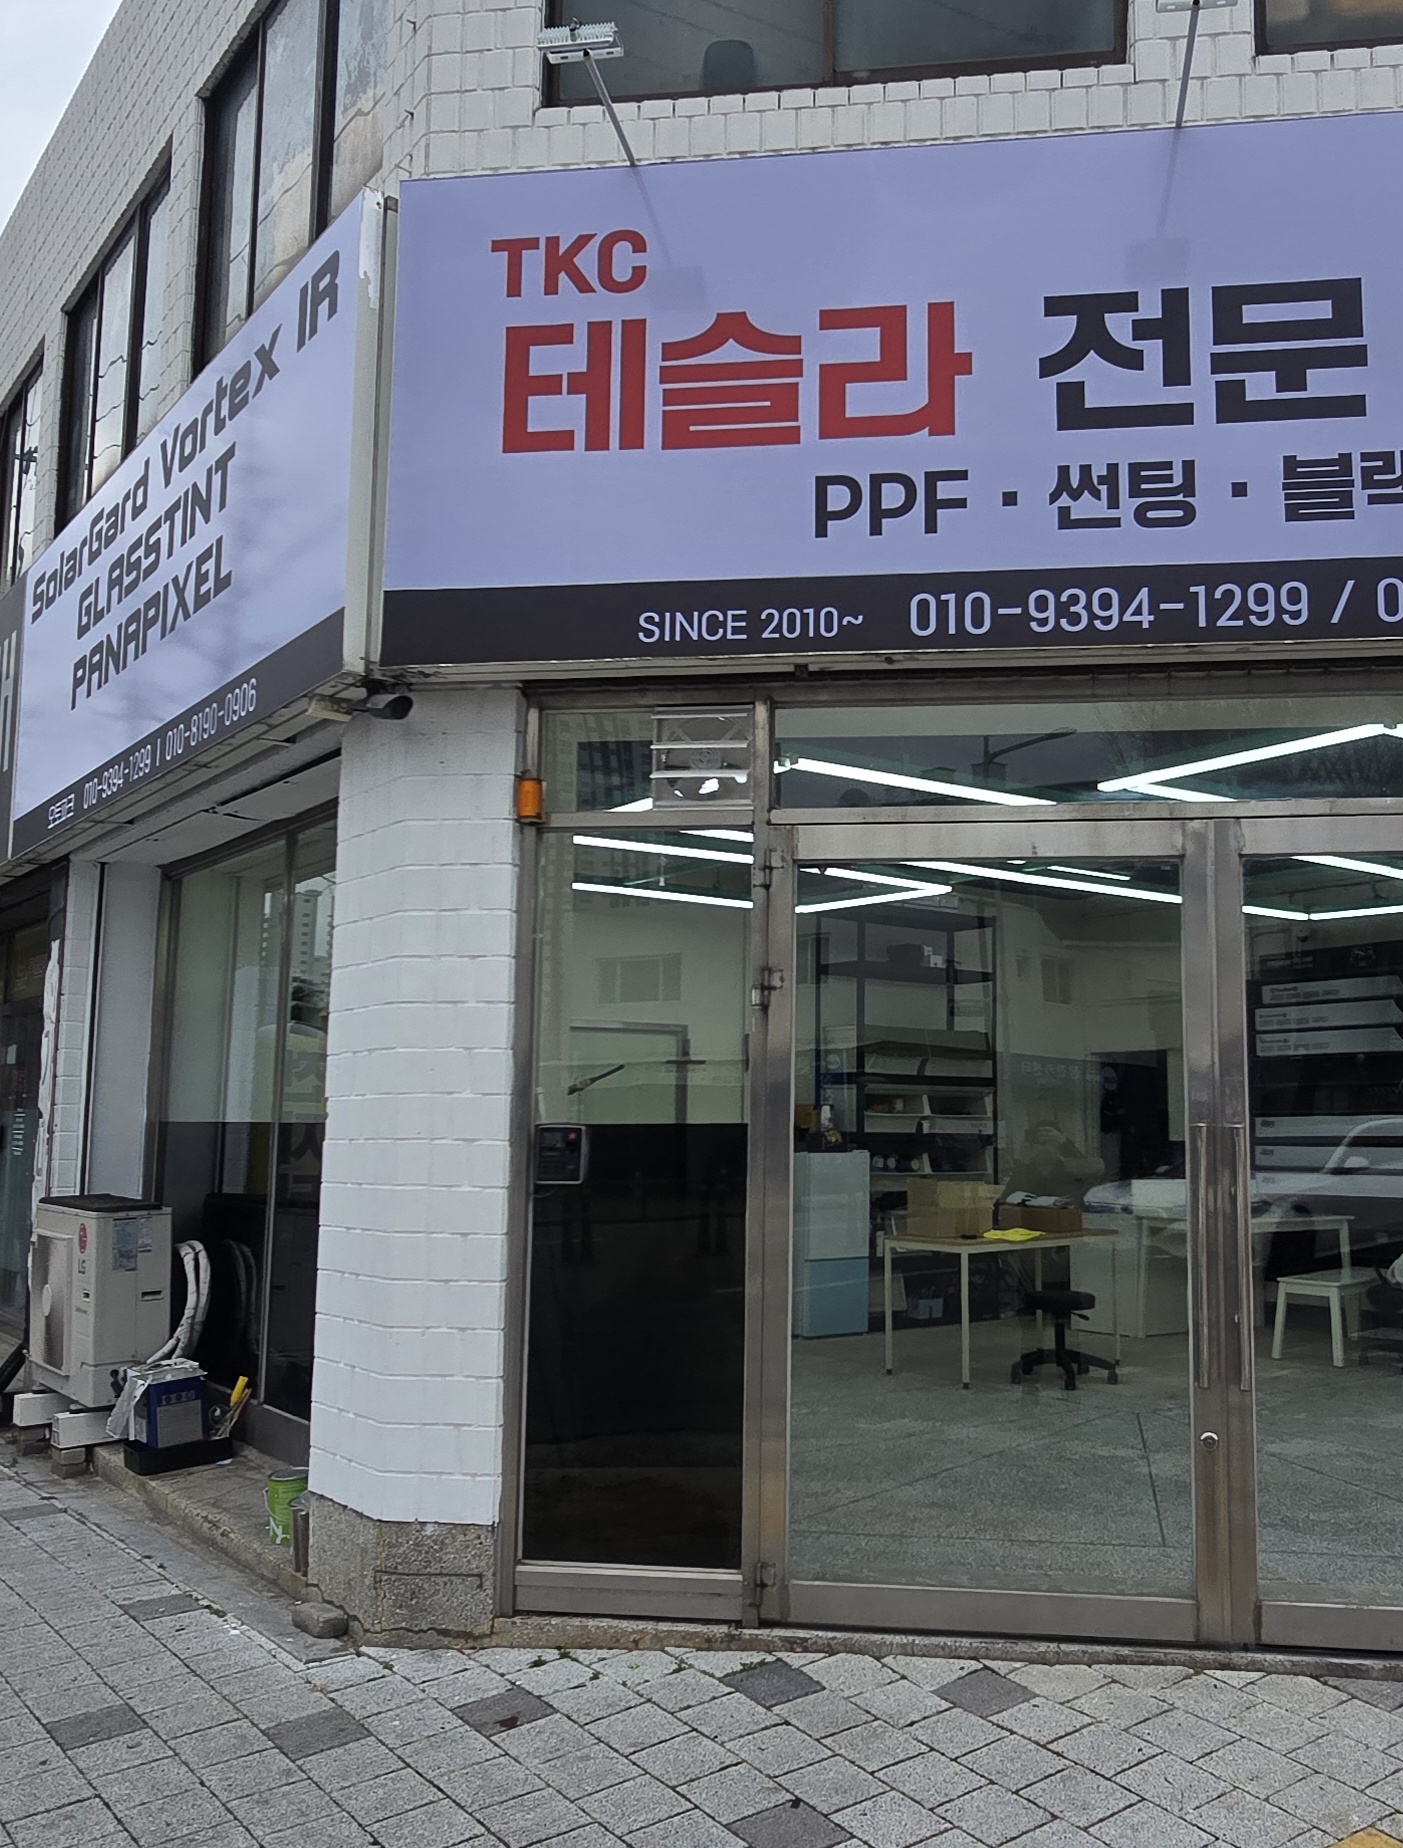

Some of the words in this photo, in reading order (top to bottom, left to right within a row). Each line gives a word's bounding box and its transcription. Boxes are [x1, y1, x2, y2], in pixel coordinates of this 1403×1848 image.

[491, 230, 648, 299] TKC
[31, 456, 150, 625] SolarGard
[160, 322, 283, 490] Vortex
[296, 249, 340, 354] IR
[502, 301, 974, 455] 테슬라
[1039, 276, 1369, 433] 전문
[76, 440, 236, 640] GLASSTINT
[813, 469, 970, 540] PPF
[1048, 459, 1198, 530] 썬팅
[71, 535, 233, 711] PANAPIXEL
[638, 610, 748, 643] SINCE
[761, 606, 864, 640] 2010~
[909, 581, 1309, 637] 010-9394-1299
[83, 744, 151, 809] 010-9394-1299
[165, 677, 257, 761] 010-8190-0906
